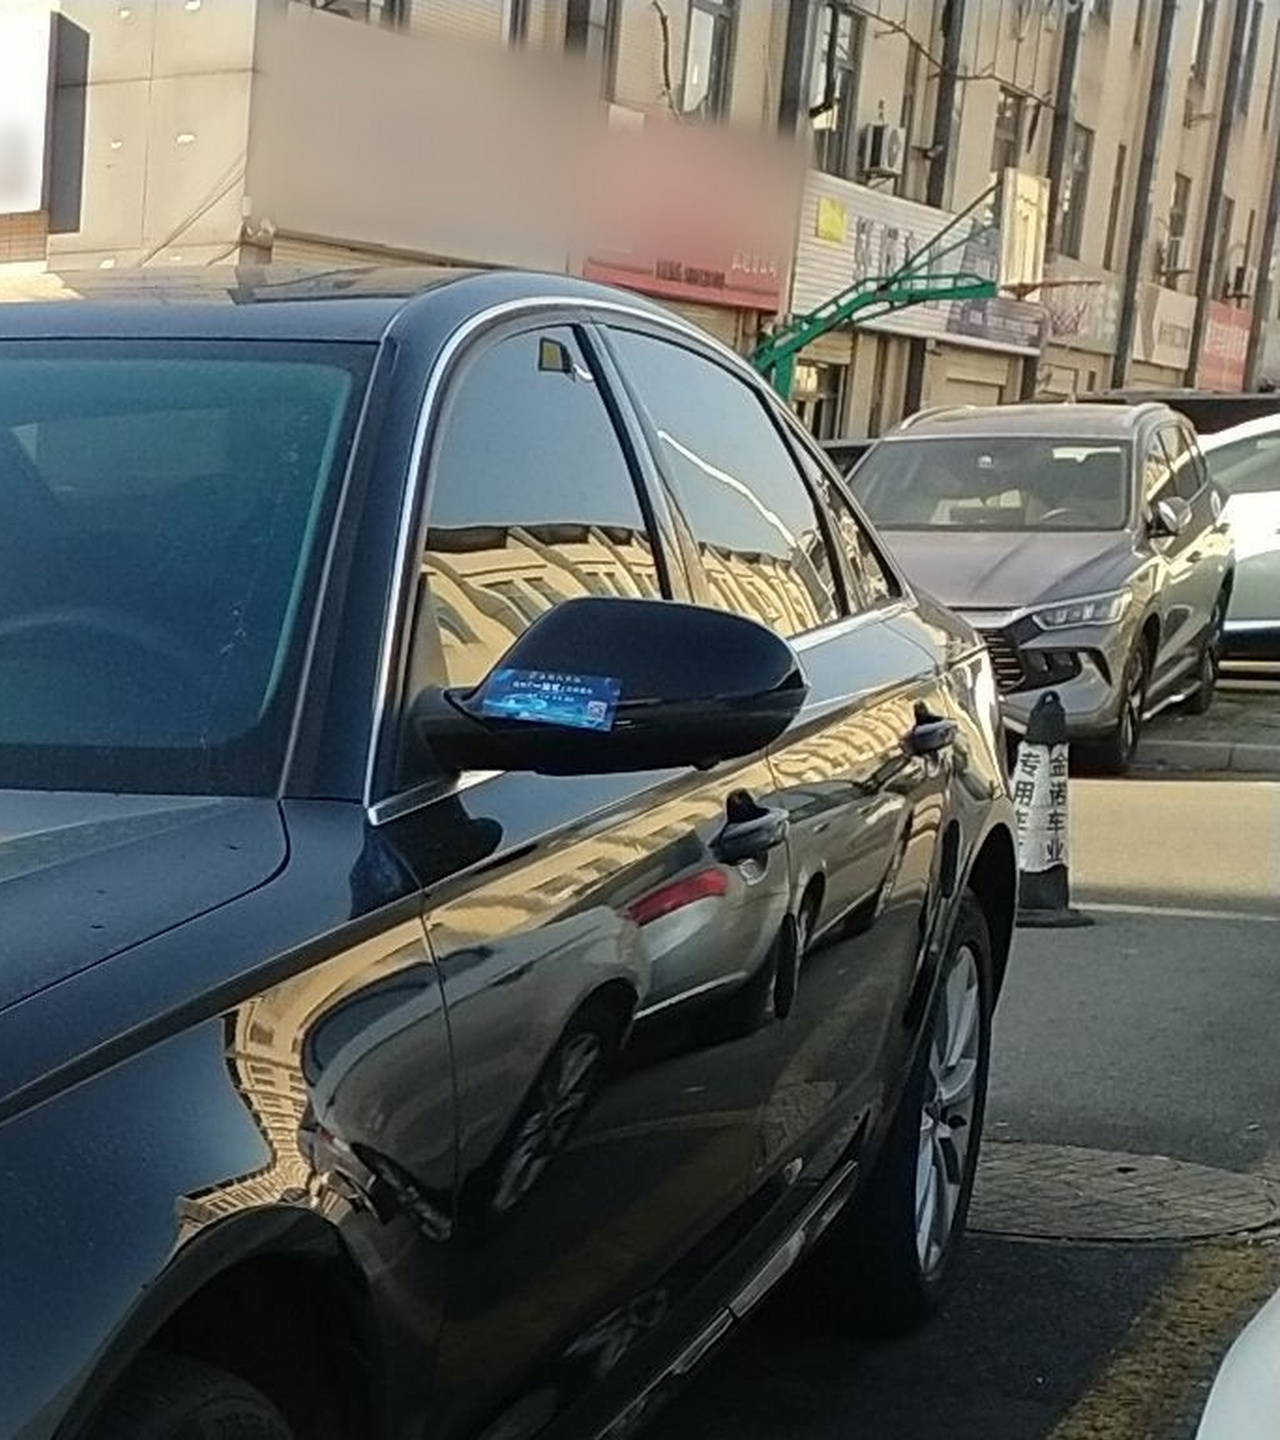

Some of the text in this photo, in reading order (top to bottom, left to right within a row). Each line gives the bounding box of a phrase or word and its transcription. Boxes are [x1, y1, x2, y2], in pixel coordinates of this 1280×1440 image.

[1013, 752, 1040, 847] 专用
[1046, 752, 1067, 863] 金诺车业
